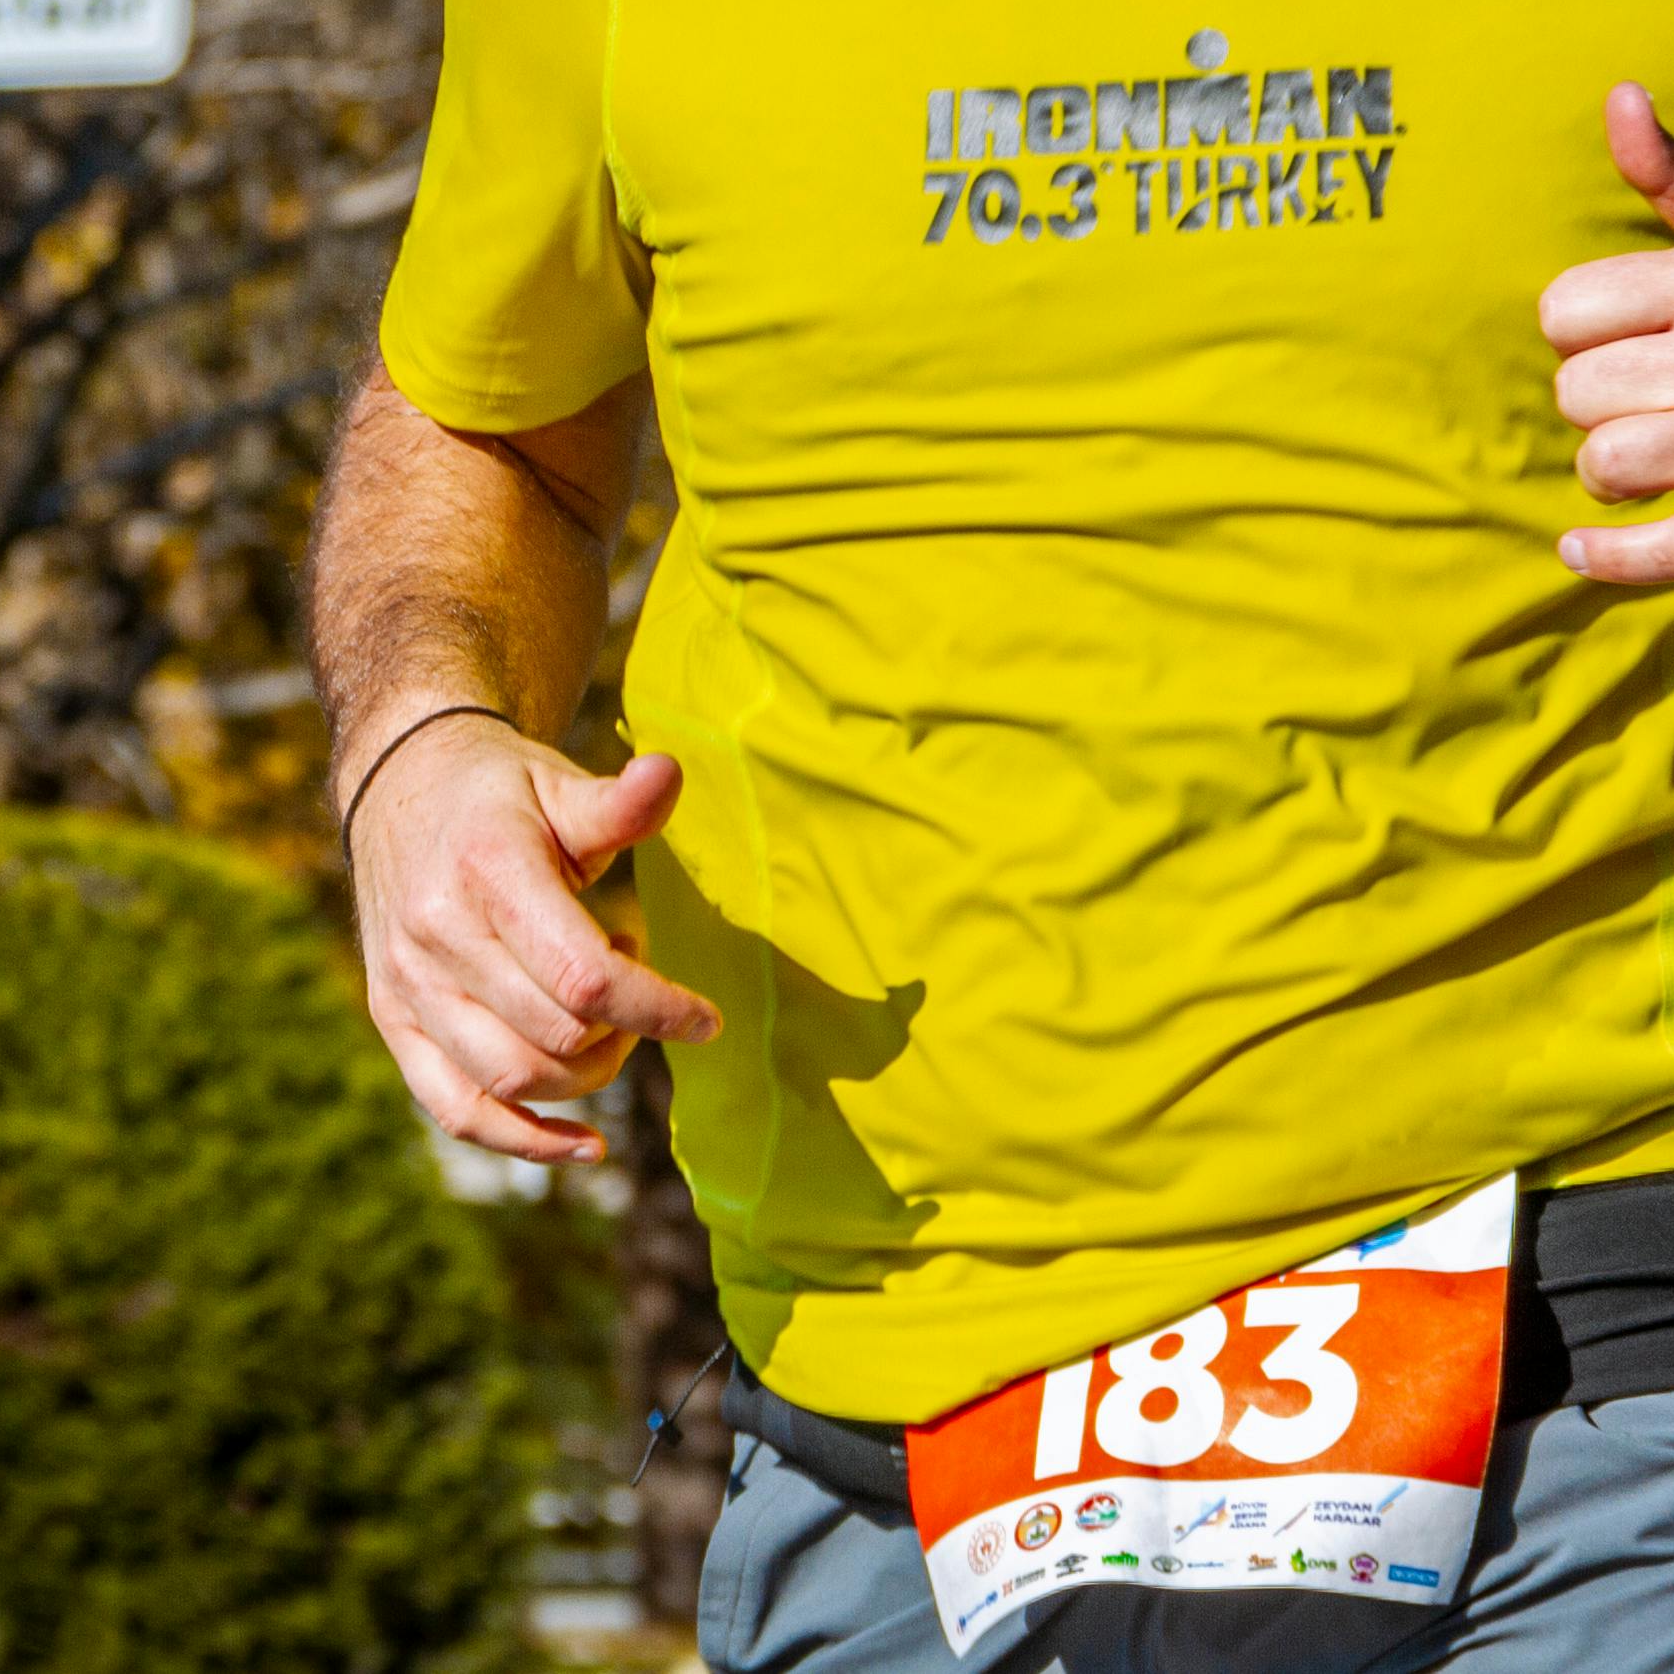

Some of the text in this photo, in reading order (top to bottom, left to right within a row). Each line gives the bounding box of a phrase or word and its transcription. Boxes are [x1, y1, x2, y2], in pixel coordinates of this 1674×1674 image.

[926, 66, 1394, 161] IRONMAN
[922, 146, 1395, 245] 70.3 TURKEY
[1034, 1283, 1360, 1481] 183
